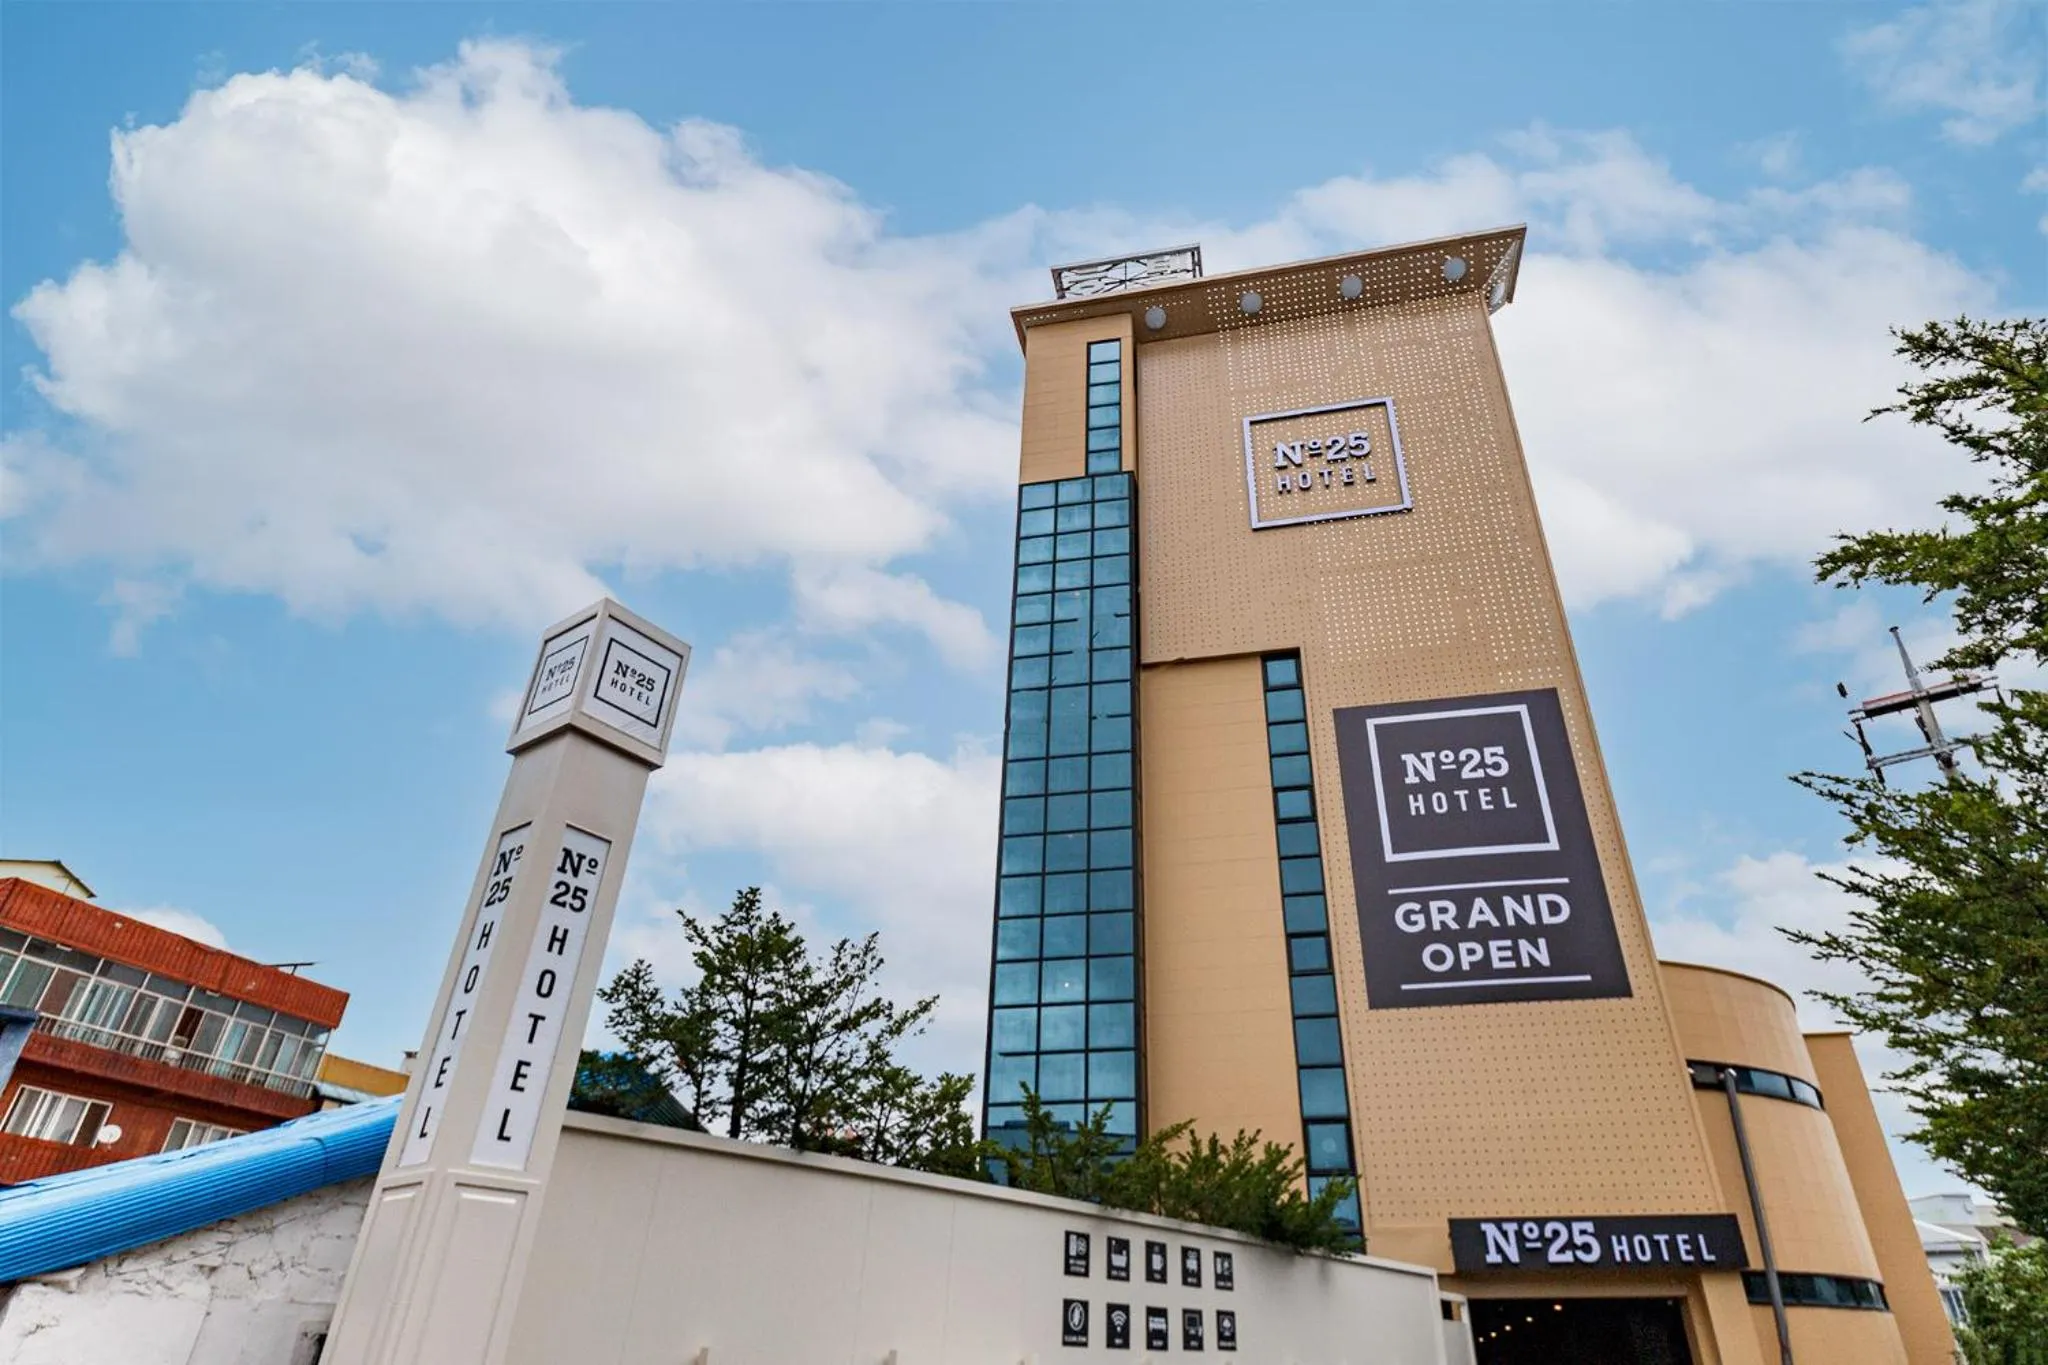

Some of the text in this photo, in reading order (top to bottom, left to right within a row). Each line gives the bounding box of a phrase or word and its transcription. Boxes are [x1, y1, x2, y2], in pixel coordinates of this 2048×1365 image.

[1276, 462, 1376, 494] HOTEL
[542, 674, 570, 694] HOTEL
[610, 677, 652, 706] HOTEL
[1408, 787, 1517, 816] HOTEL
[485, 876, 513, 908] 25
[550, 880, 588, 913] 25
[1394, 893, 1571, 933] GRAND
[1422, 938, 1551, 973] OPEN
[418, 921, 494, 1139] HOTEL
[497, 925, 569, 1142] HOTEL
[1611, 1234, 1716, 1262] HOTEL
